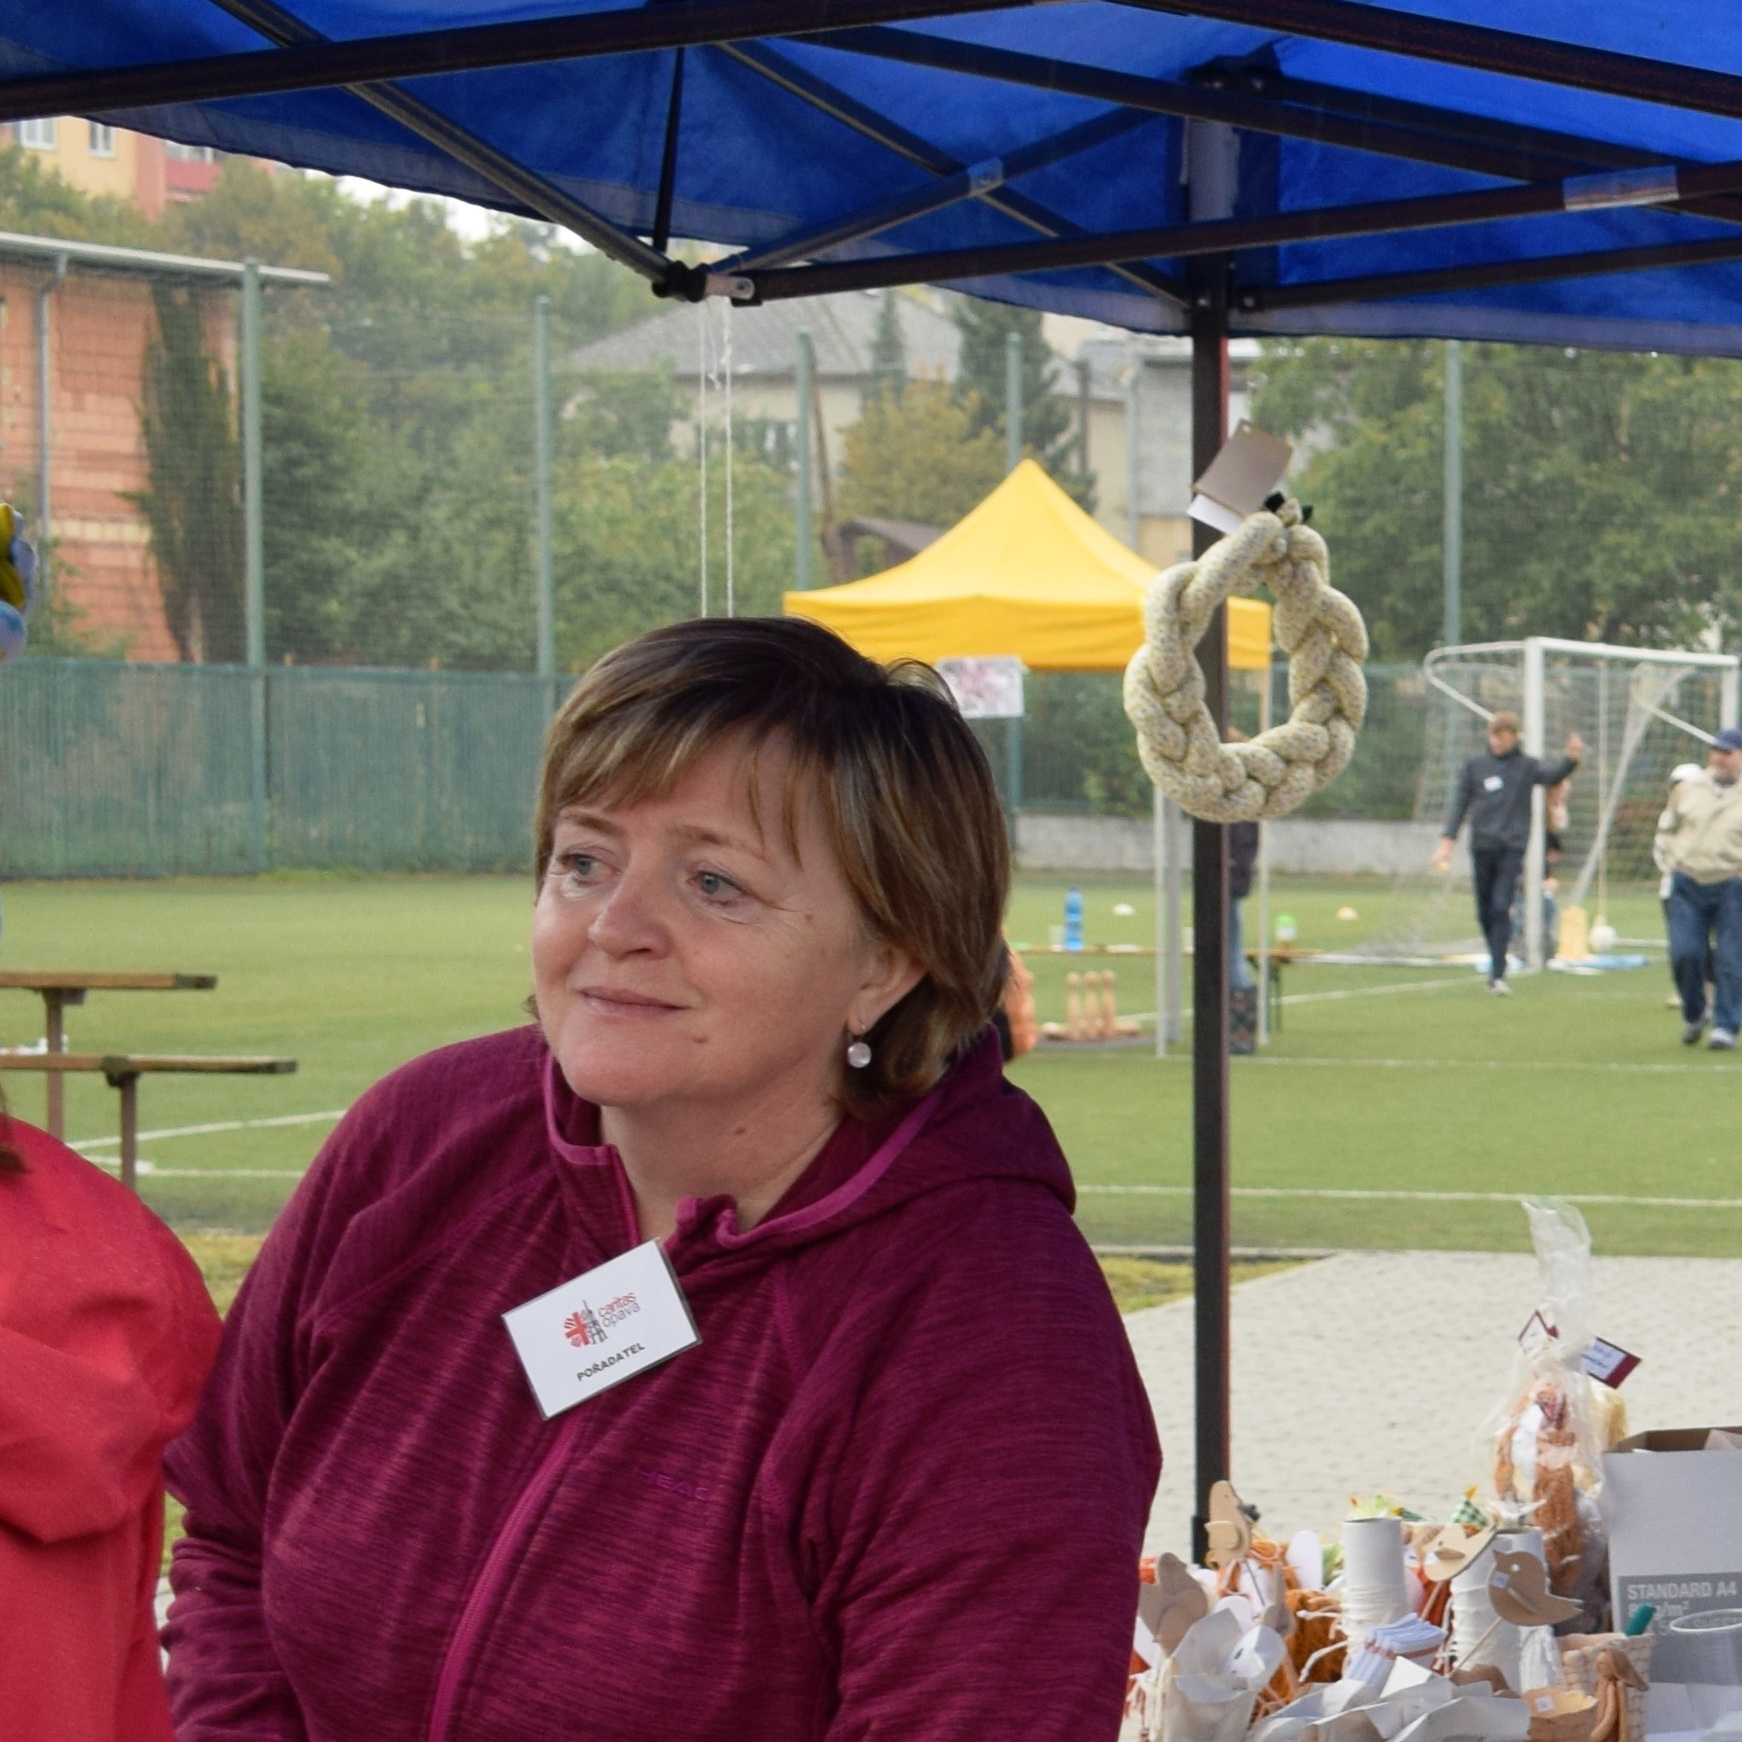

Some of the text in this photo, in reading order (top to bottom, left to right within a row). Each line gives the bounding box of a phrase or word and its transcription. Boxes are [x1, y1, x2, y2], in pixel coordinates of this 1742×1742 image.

[598, 1292, 637, 1318] caritas
[602, 1302, 642, 1329] opava
[1627, 1580, 1738, 1600] STANDARD A4
